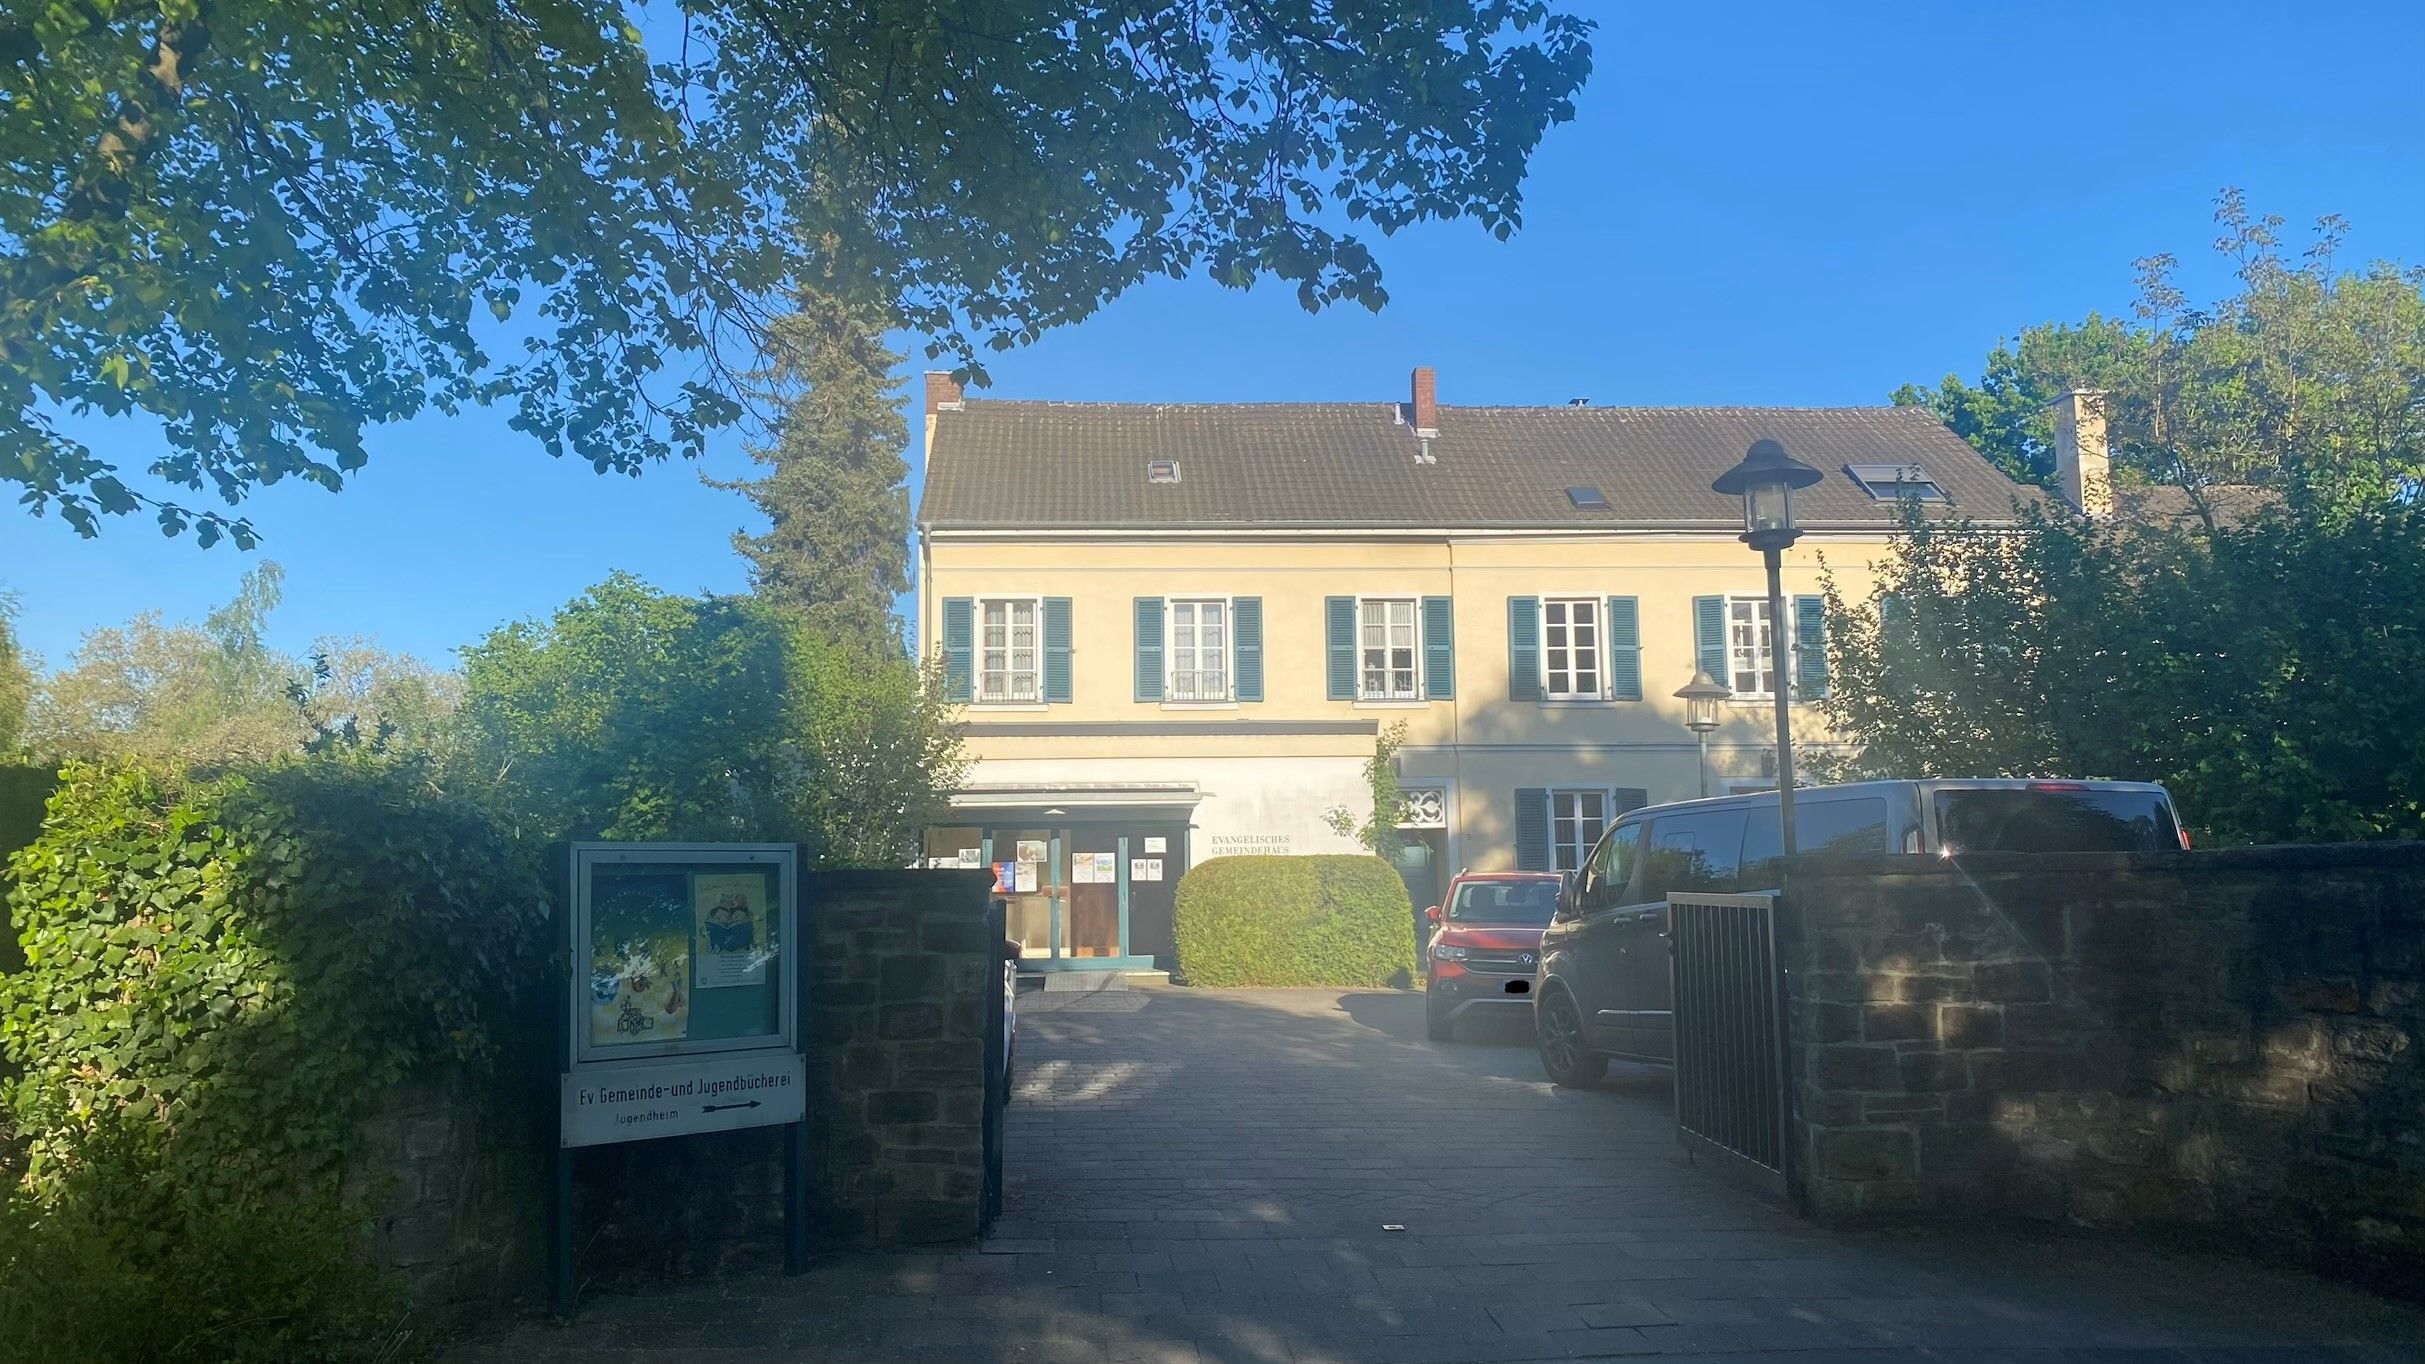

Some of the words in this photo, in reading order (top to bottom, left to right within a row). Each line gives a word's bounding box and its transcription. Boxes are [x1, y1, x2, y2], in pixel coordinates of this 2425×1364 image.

[1212, 835, 1290, 844] EVANGELISCHES
[1211, 846, 1289, 855] GEMEINDEHAUS
[698, 1071, 791, 1098] Jugendbücherei
[614, 1110, 679, 1126] Jugendheim
